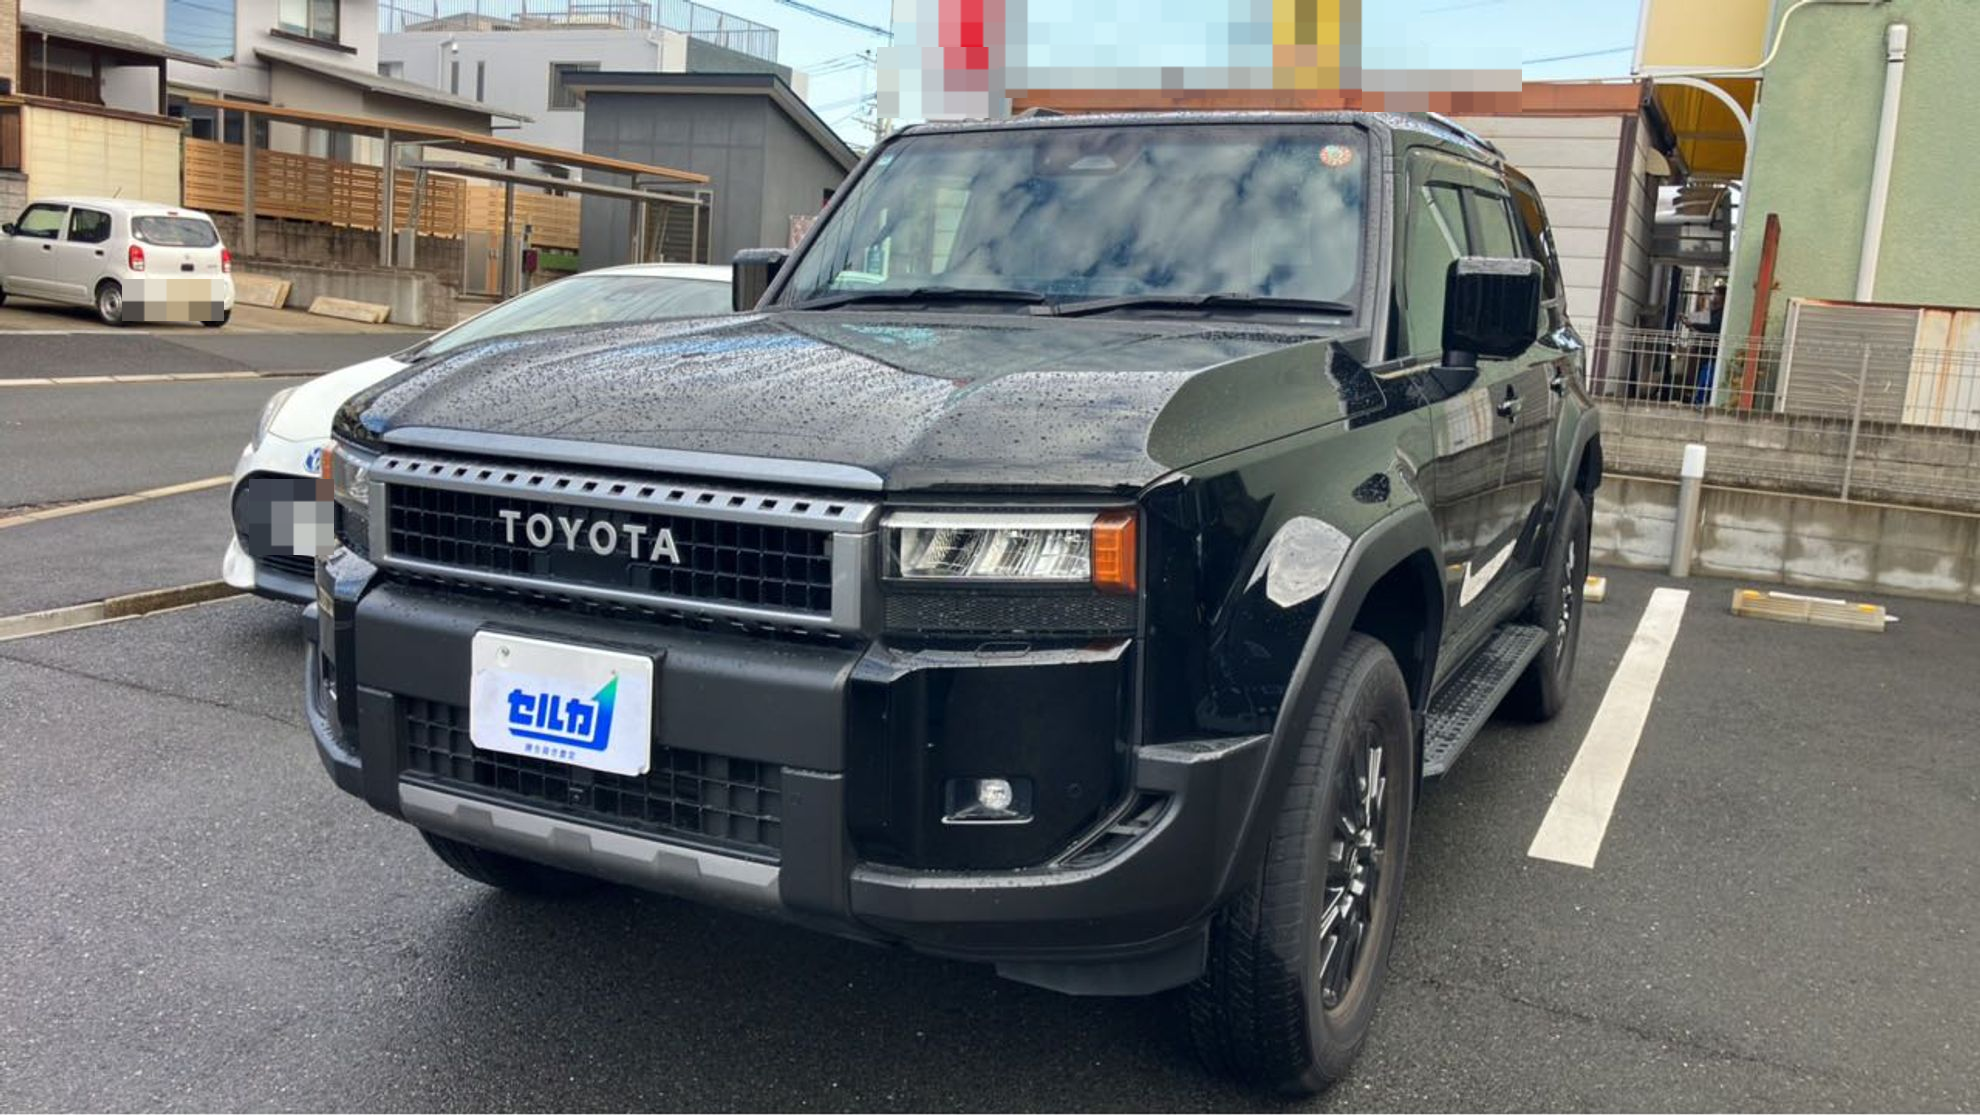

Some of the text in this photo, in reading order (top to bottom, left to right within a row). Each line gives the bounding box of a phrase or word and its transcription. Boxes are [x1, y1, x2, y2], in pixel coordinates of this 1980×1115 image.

[499, 509, 681, 564] TOYOTA
[507, 688, 594, 737] セルカ
